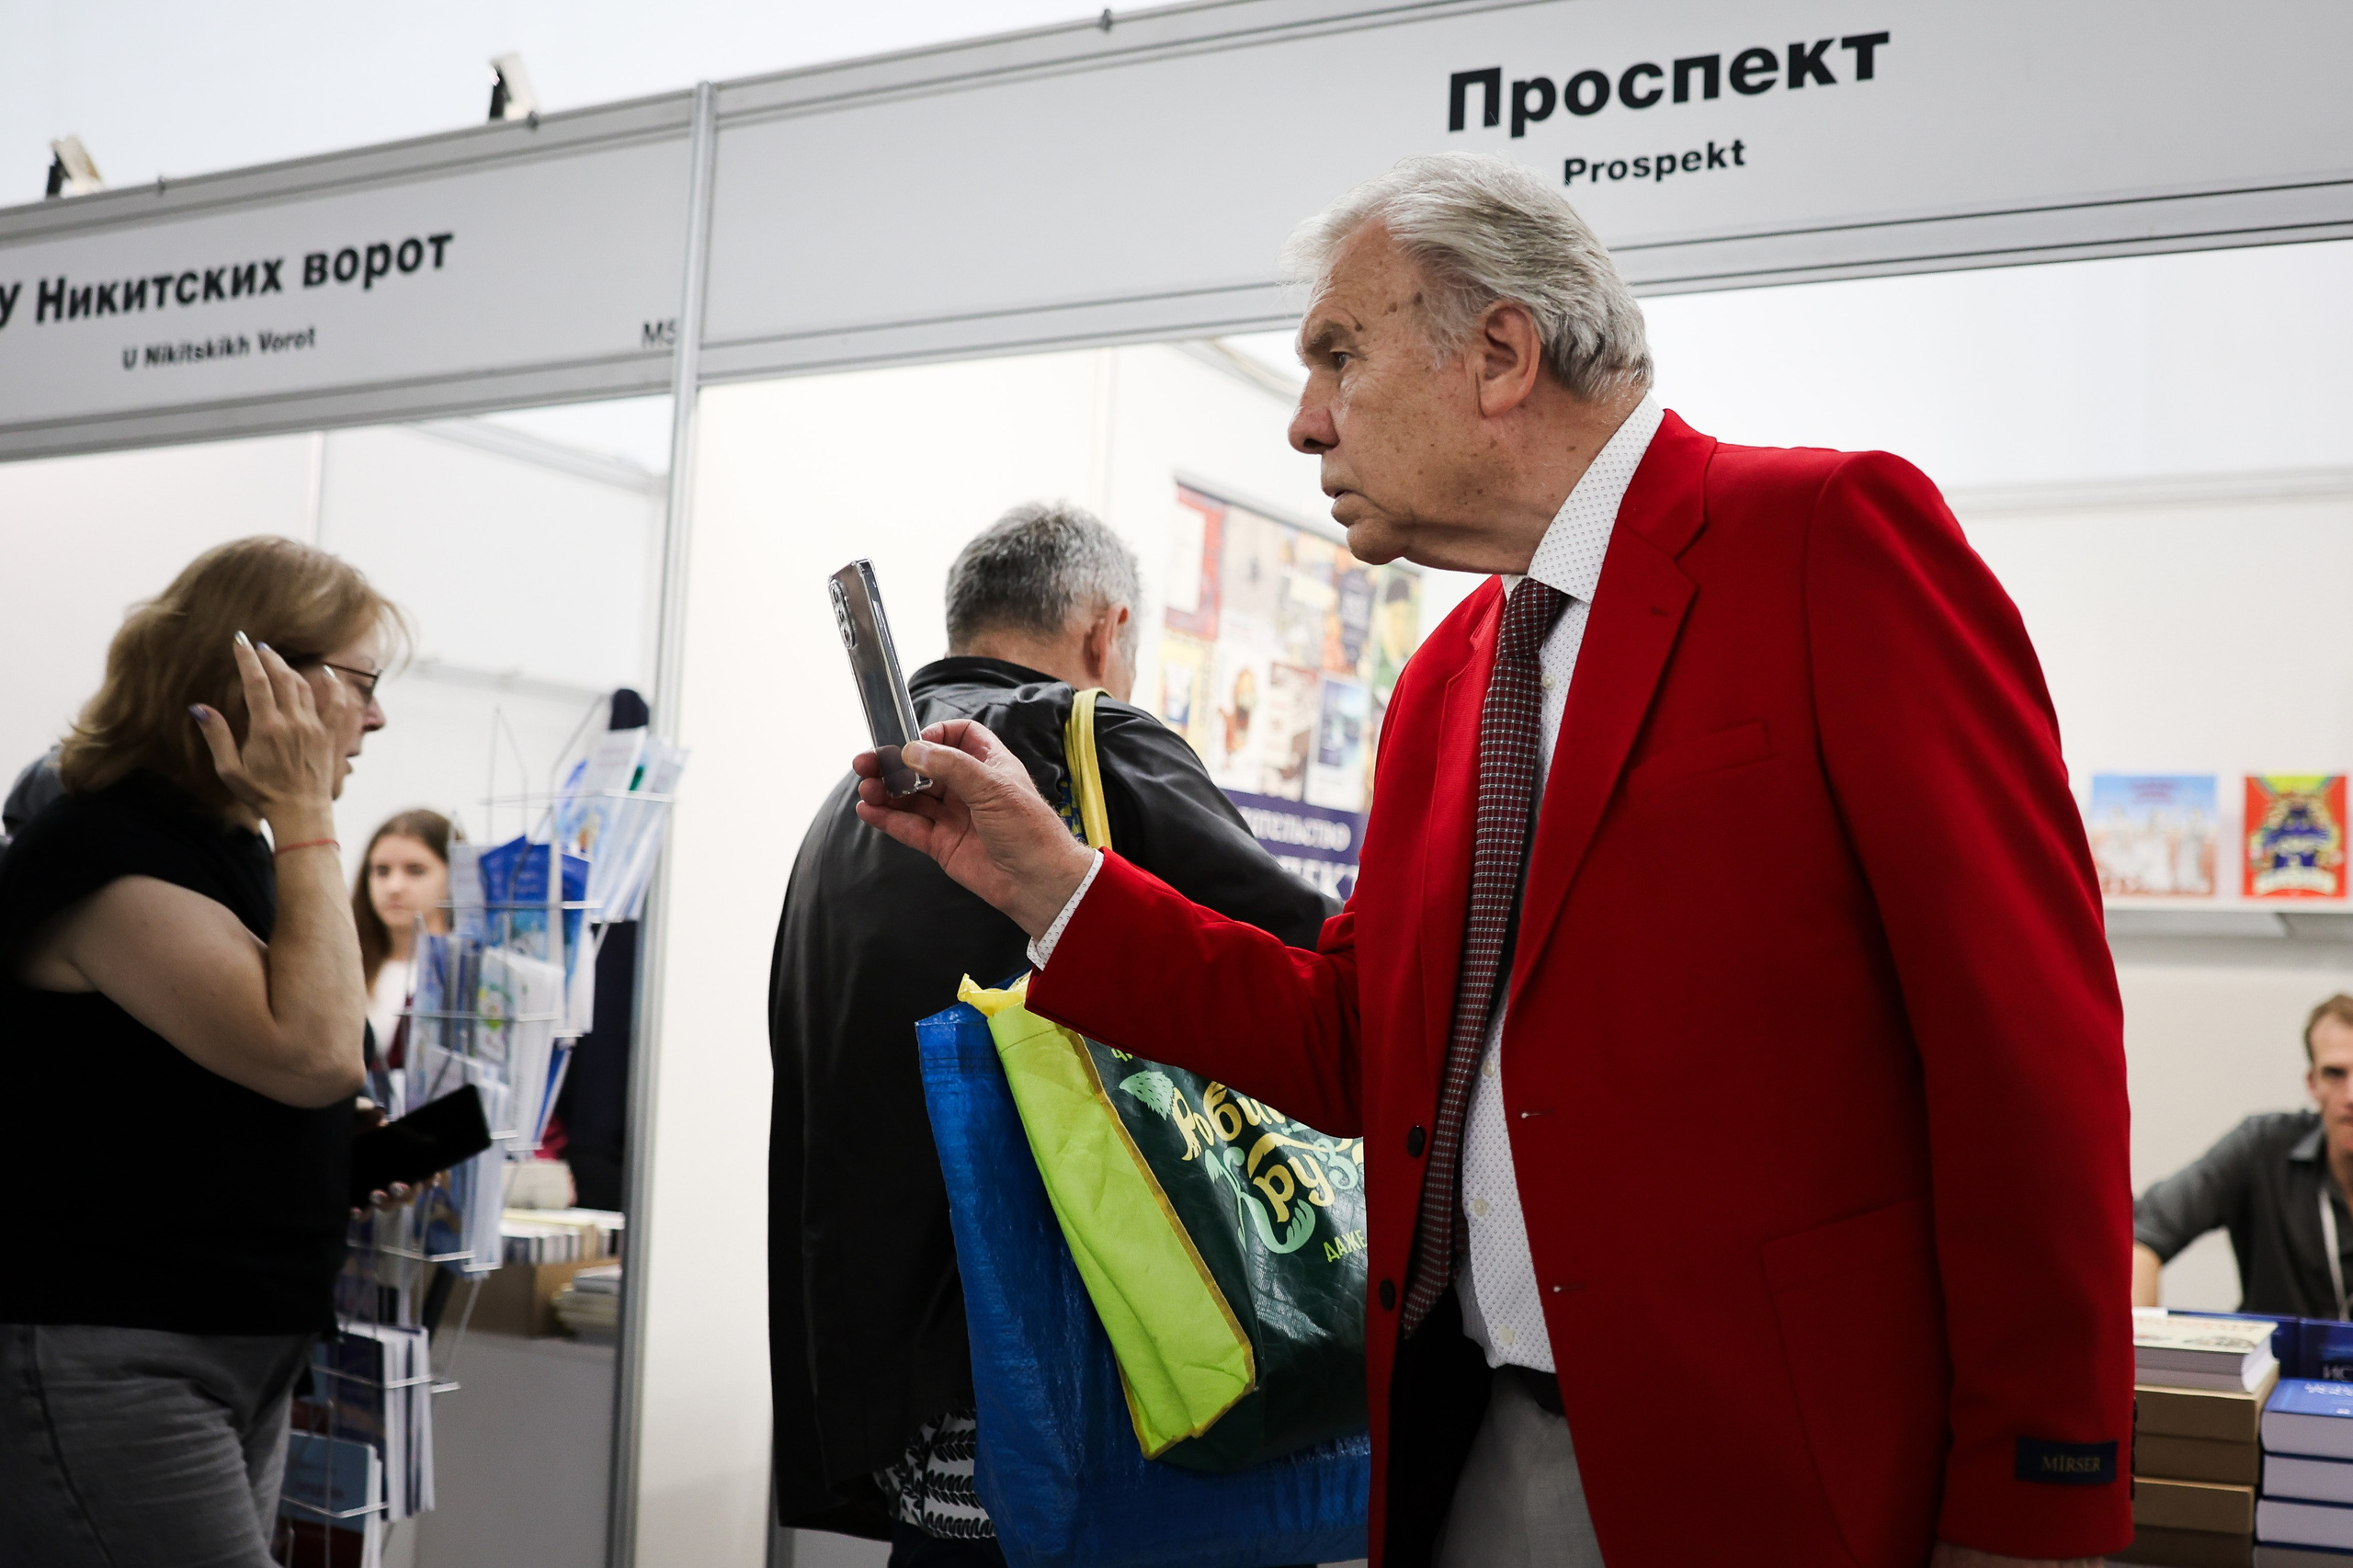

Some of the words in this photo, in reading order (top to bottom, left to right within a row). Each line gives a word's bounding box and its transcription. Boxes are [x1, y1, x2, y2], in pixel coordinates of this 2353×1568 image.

[1449, 30, 1891, 139] Проспект
[1563, 139, 1746, 186] Prospekt
[35, 258, 285, 324] Никитских
[302, 233, 454, 290] ворот
[121, 347, 139, 371] U
[144, 335, 251, 368] Nikitskikh
[257, 325, 316, 354] Vorot
[1323, 1229, 1368, 1263] ДАЖЕ
